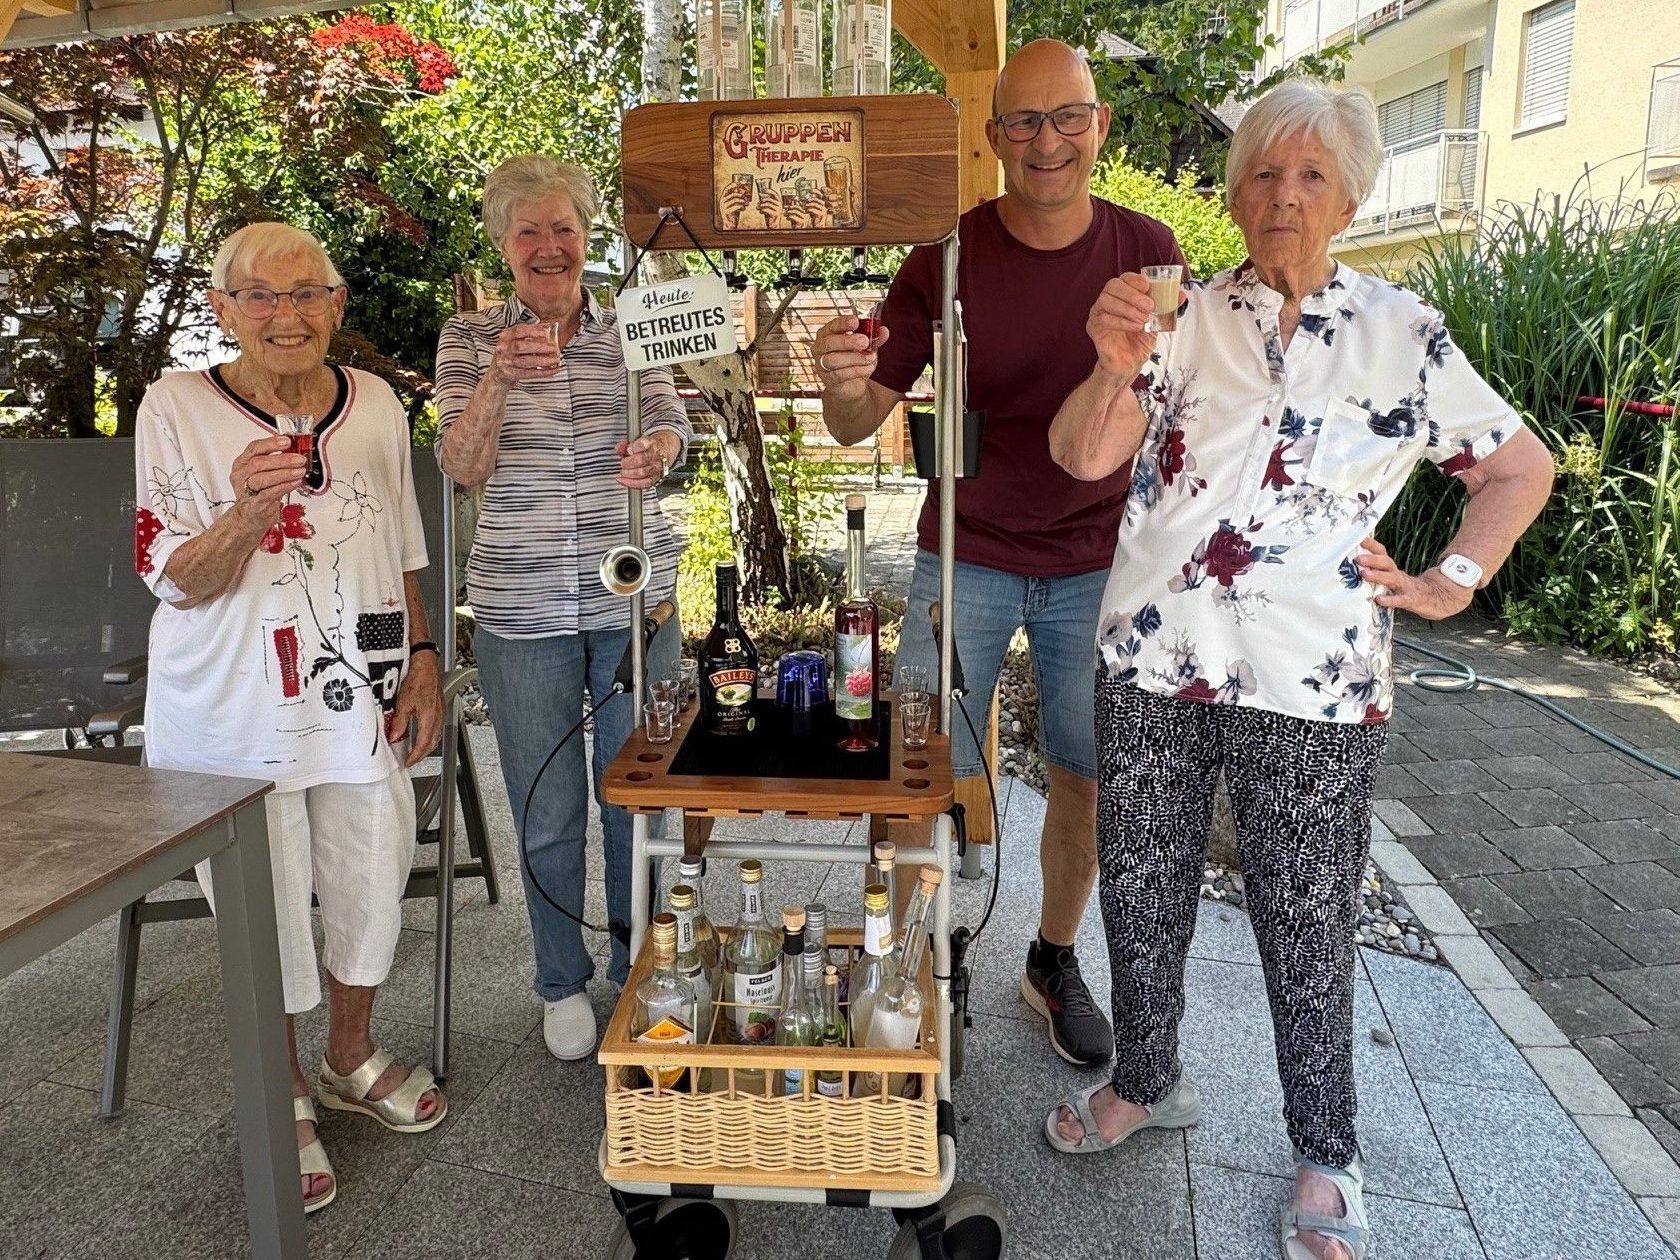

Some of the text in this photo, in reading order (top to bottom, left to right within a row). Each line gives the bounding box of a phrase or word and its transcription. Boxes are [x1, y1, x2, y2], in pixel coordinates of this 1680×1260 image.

[722, 121, 851, 159] GRUPPEN
[749, 146, 824, 170] THERAPIE
[776, 164, 804, 183] hier
[625, 306, 726, 341] BETREUTES
[641, 332, 717, 362] TRINKEN
[712, 671, 755, 684] BAILEYS
[717, 709, 751, 717] ORIGINAL
